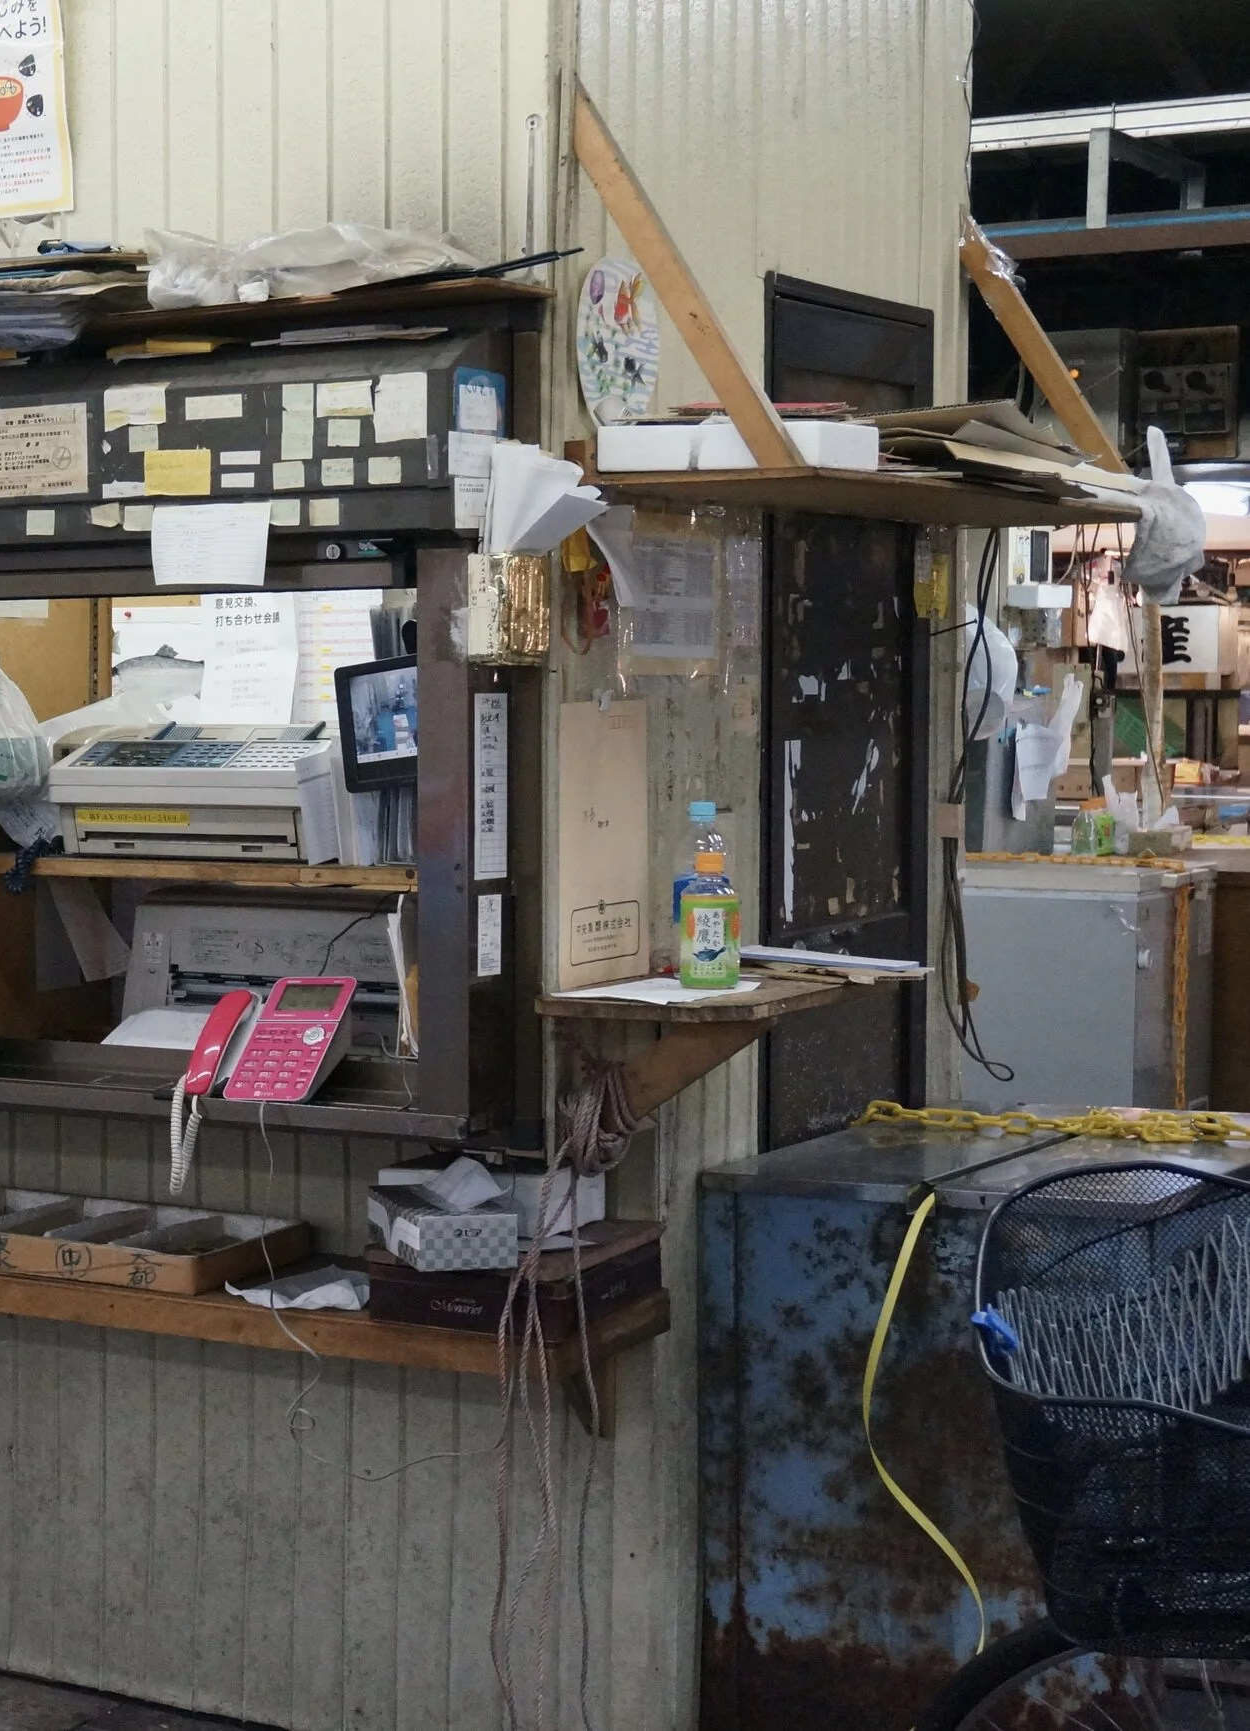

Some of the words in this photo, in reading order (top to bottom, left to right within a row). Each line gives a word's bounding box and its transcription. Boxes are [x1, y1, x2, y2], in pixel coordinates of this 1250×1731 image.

[215, 596, 258, 609] 意見交換、
[215, 611, 280, 627] 打ち合わせ会議
